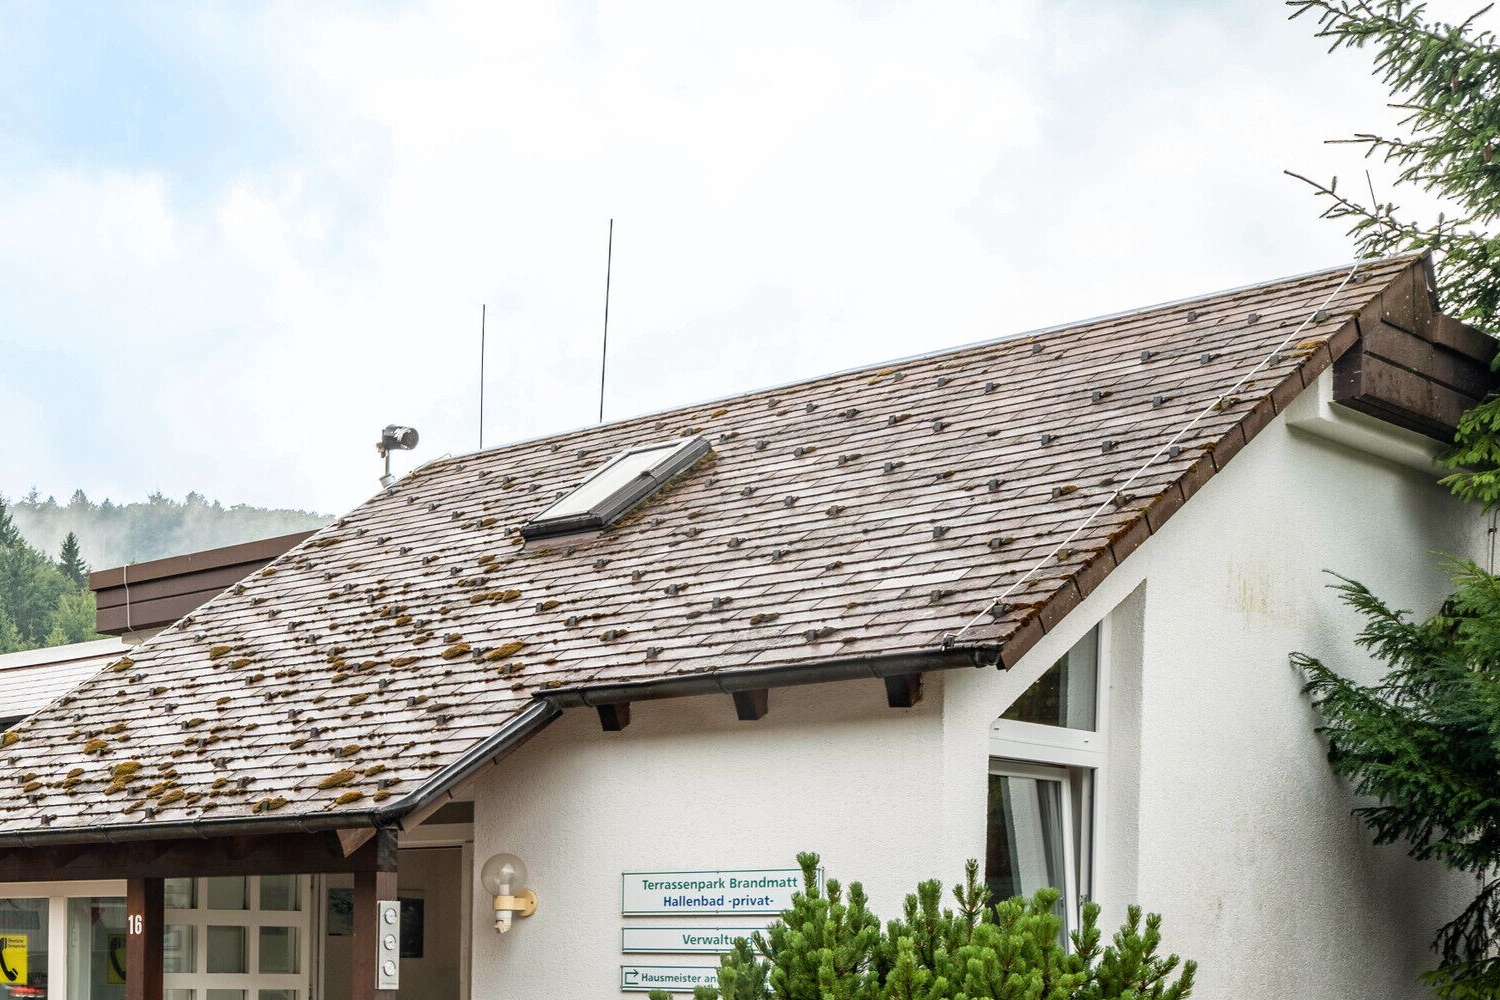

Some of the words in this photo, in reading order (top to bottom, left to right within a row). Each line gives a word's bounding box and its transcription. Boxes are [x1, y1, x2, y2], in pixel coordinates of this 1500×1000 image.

[642, 878, 725, 891] Terrassenpark
[729, 876, 798, 889] Brandmatt
[663, 895, 725, 907] Hallenbad
[728, 895, 774, 909] -privat-
[128, 914, 142, 935] 16
[682, 934, 754, 947] Verwaltug
[641, 973, 701, 983] Hausmeister
